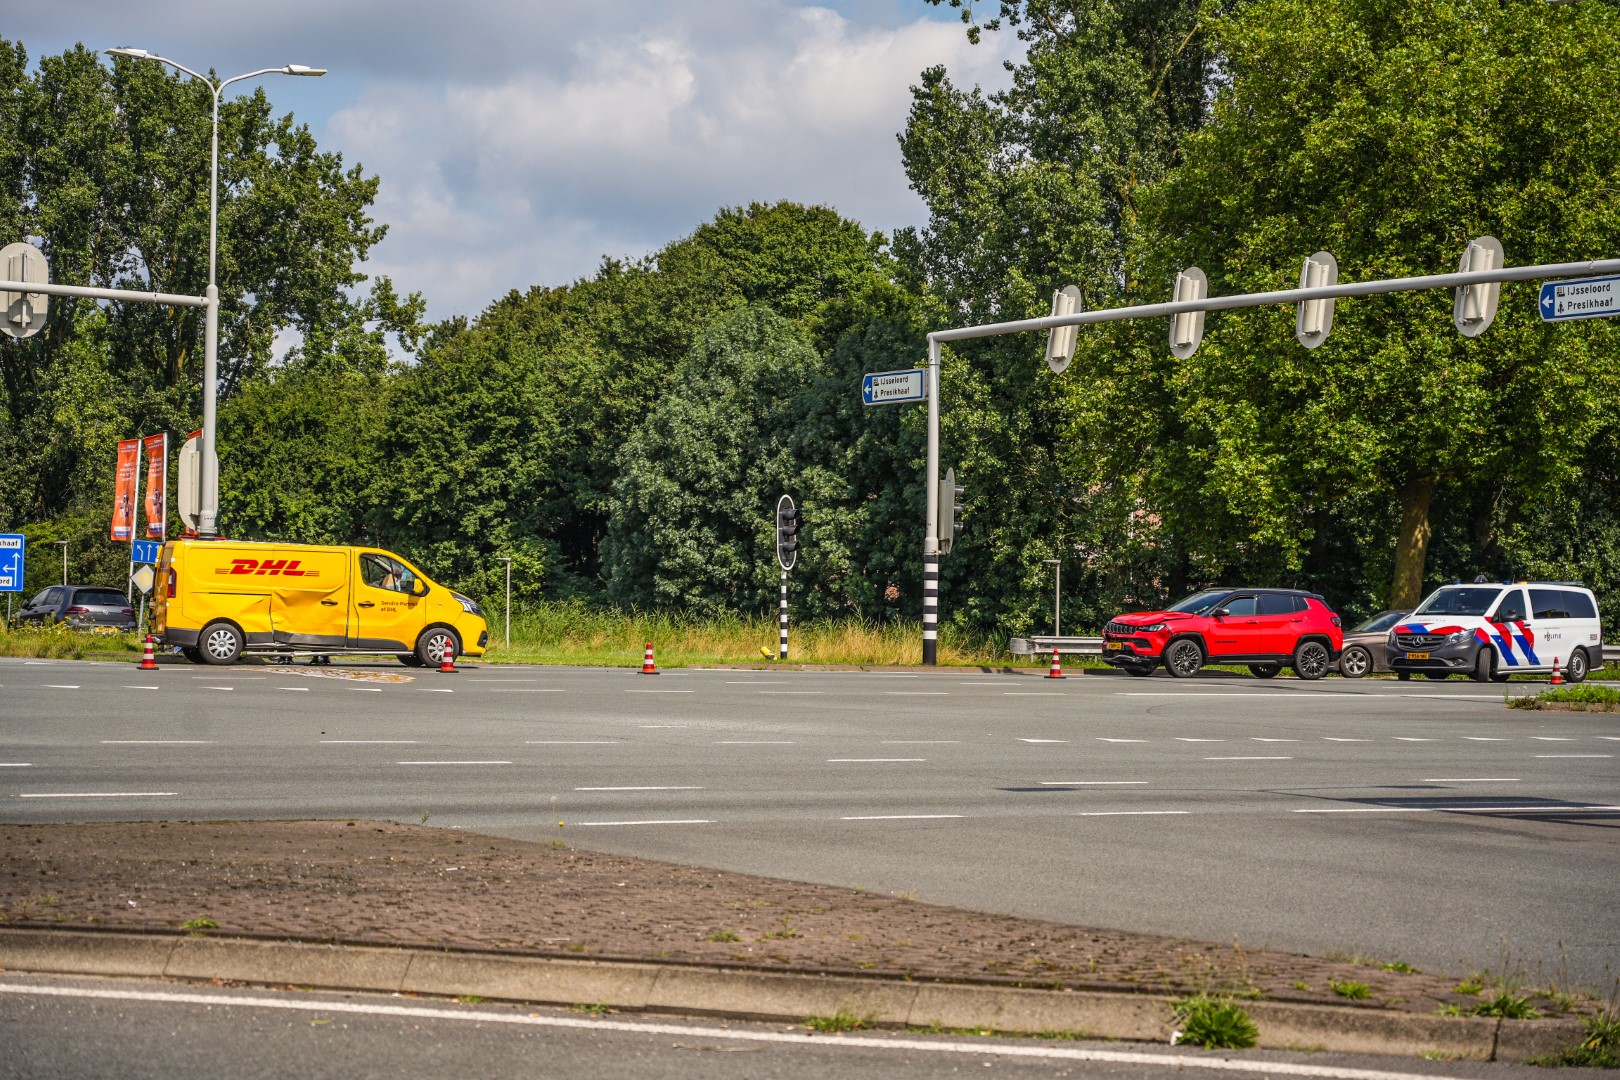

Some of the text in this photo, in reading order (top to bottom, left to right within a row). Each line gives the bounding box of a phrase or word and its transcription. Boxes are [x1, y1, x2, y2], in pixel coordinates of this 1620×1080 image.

[1567, 282, 1611, 296] IJsseloord
[1567, 297, 1613, 310] Presikhaaf
[229, 558, 306, 577] DHL
